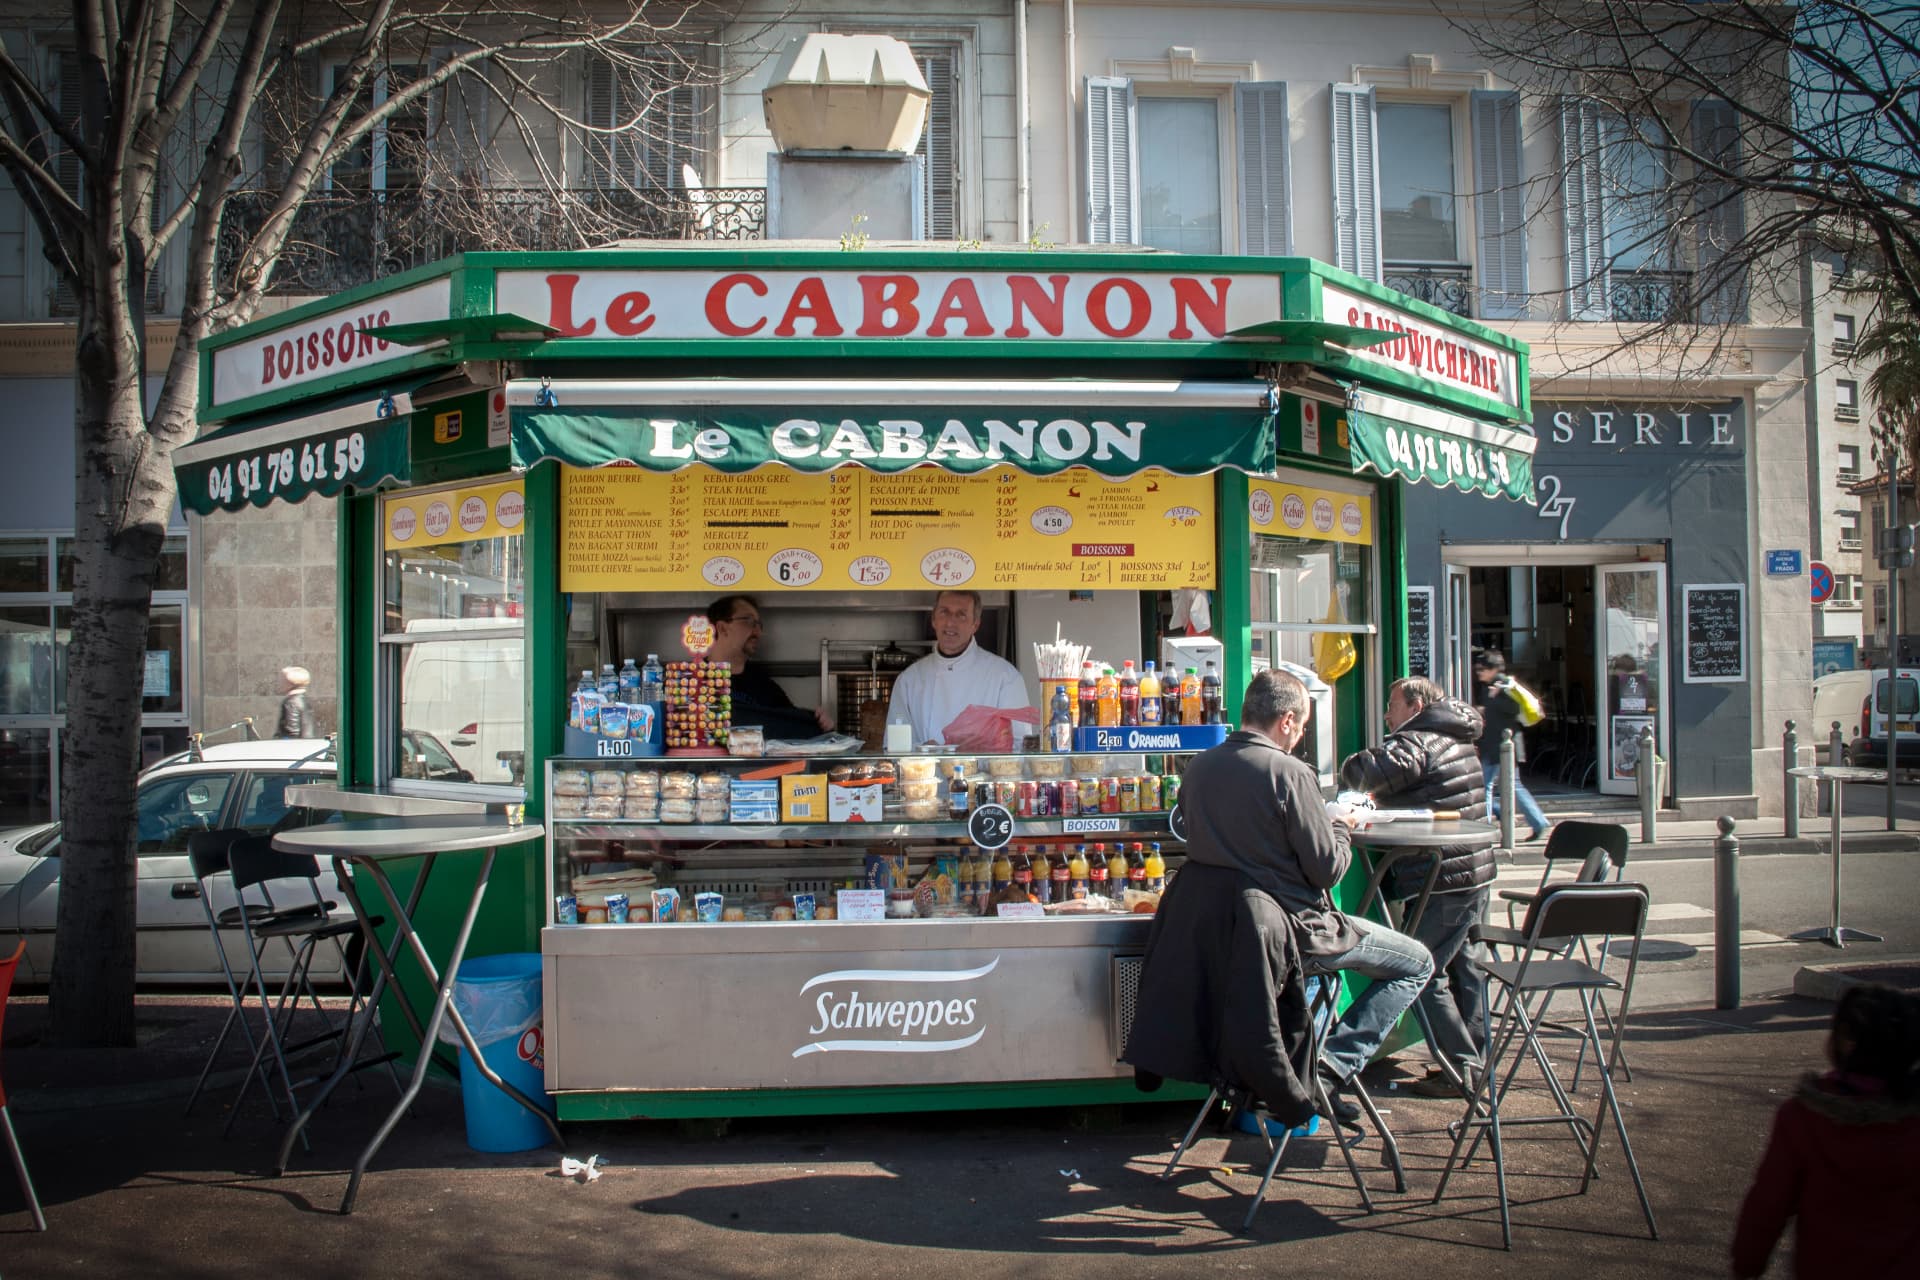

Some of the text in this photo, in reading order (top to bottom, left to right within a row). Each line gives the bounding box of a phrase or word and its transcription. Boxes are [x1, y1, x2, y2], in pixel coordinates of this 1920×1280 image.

[546, 274, 1232, 338] Le CABANON
[262, 310, 390, 384] BOISSONS
[649, 418, 1146, 461] Le CABANON
[1386, 426, 1414, 471] 04
[1414, 433, 1438, 475] 91
[1440, 439, 1464, 482] 78
[1466, 442, 1488, 480] 61
[209, 432, 365, 502] 04 91 78 61 58
[569, 474, 642, 484] JAMBON BEURRE
[703, 474, 791, 483] KEBAB GIROS GREC
[870, 474, 924, 484] BOULETTES
[569, 485, 605, 495] JAMBON
[703, 486, 733, 495] STEAK
[870, 486, 916, 495] ESCALOPE
[930, 486, 960, 495] DINDE
[568, 496, 615, 505] SAUCISSON
[702, 497, 727, 506] STEAK
[870, 497, 908, 506] POISSON
[1539, 475, 1576, 539] 27
[703, 508, 749, 517] ESCALOPE
[568, 519, 663, 528] POULET MAYONNAISE
[870, 520, 890, 529] HOT
[892, 520, 913, 529] DOG
[568, 530, 652, 539] PAN BAGNAT THON
[703, 531, 749, 540] MERGUEZ
[870, 531, 906, 540] POULET
[568, 541, 658, 551] PAN BAGNAT SURIMI
[703, 542, 769, 551] CORDON BLEU
[1080, 545, 1127, 555] BOISSONS
[568, 553, 600, 562] TOMATE
[602, 553, 629, 562] MOZZA
[567, 564, 600, 573] TOMATE
[994, 562, 1014, 571] EAU
[1120, 562, 1163, 571] BOISSONS
[1066, 820, 1118, 832] BOISSON
[809, 991, 977, 1036] Schweppes
